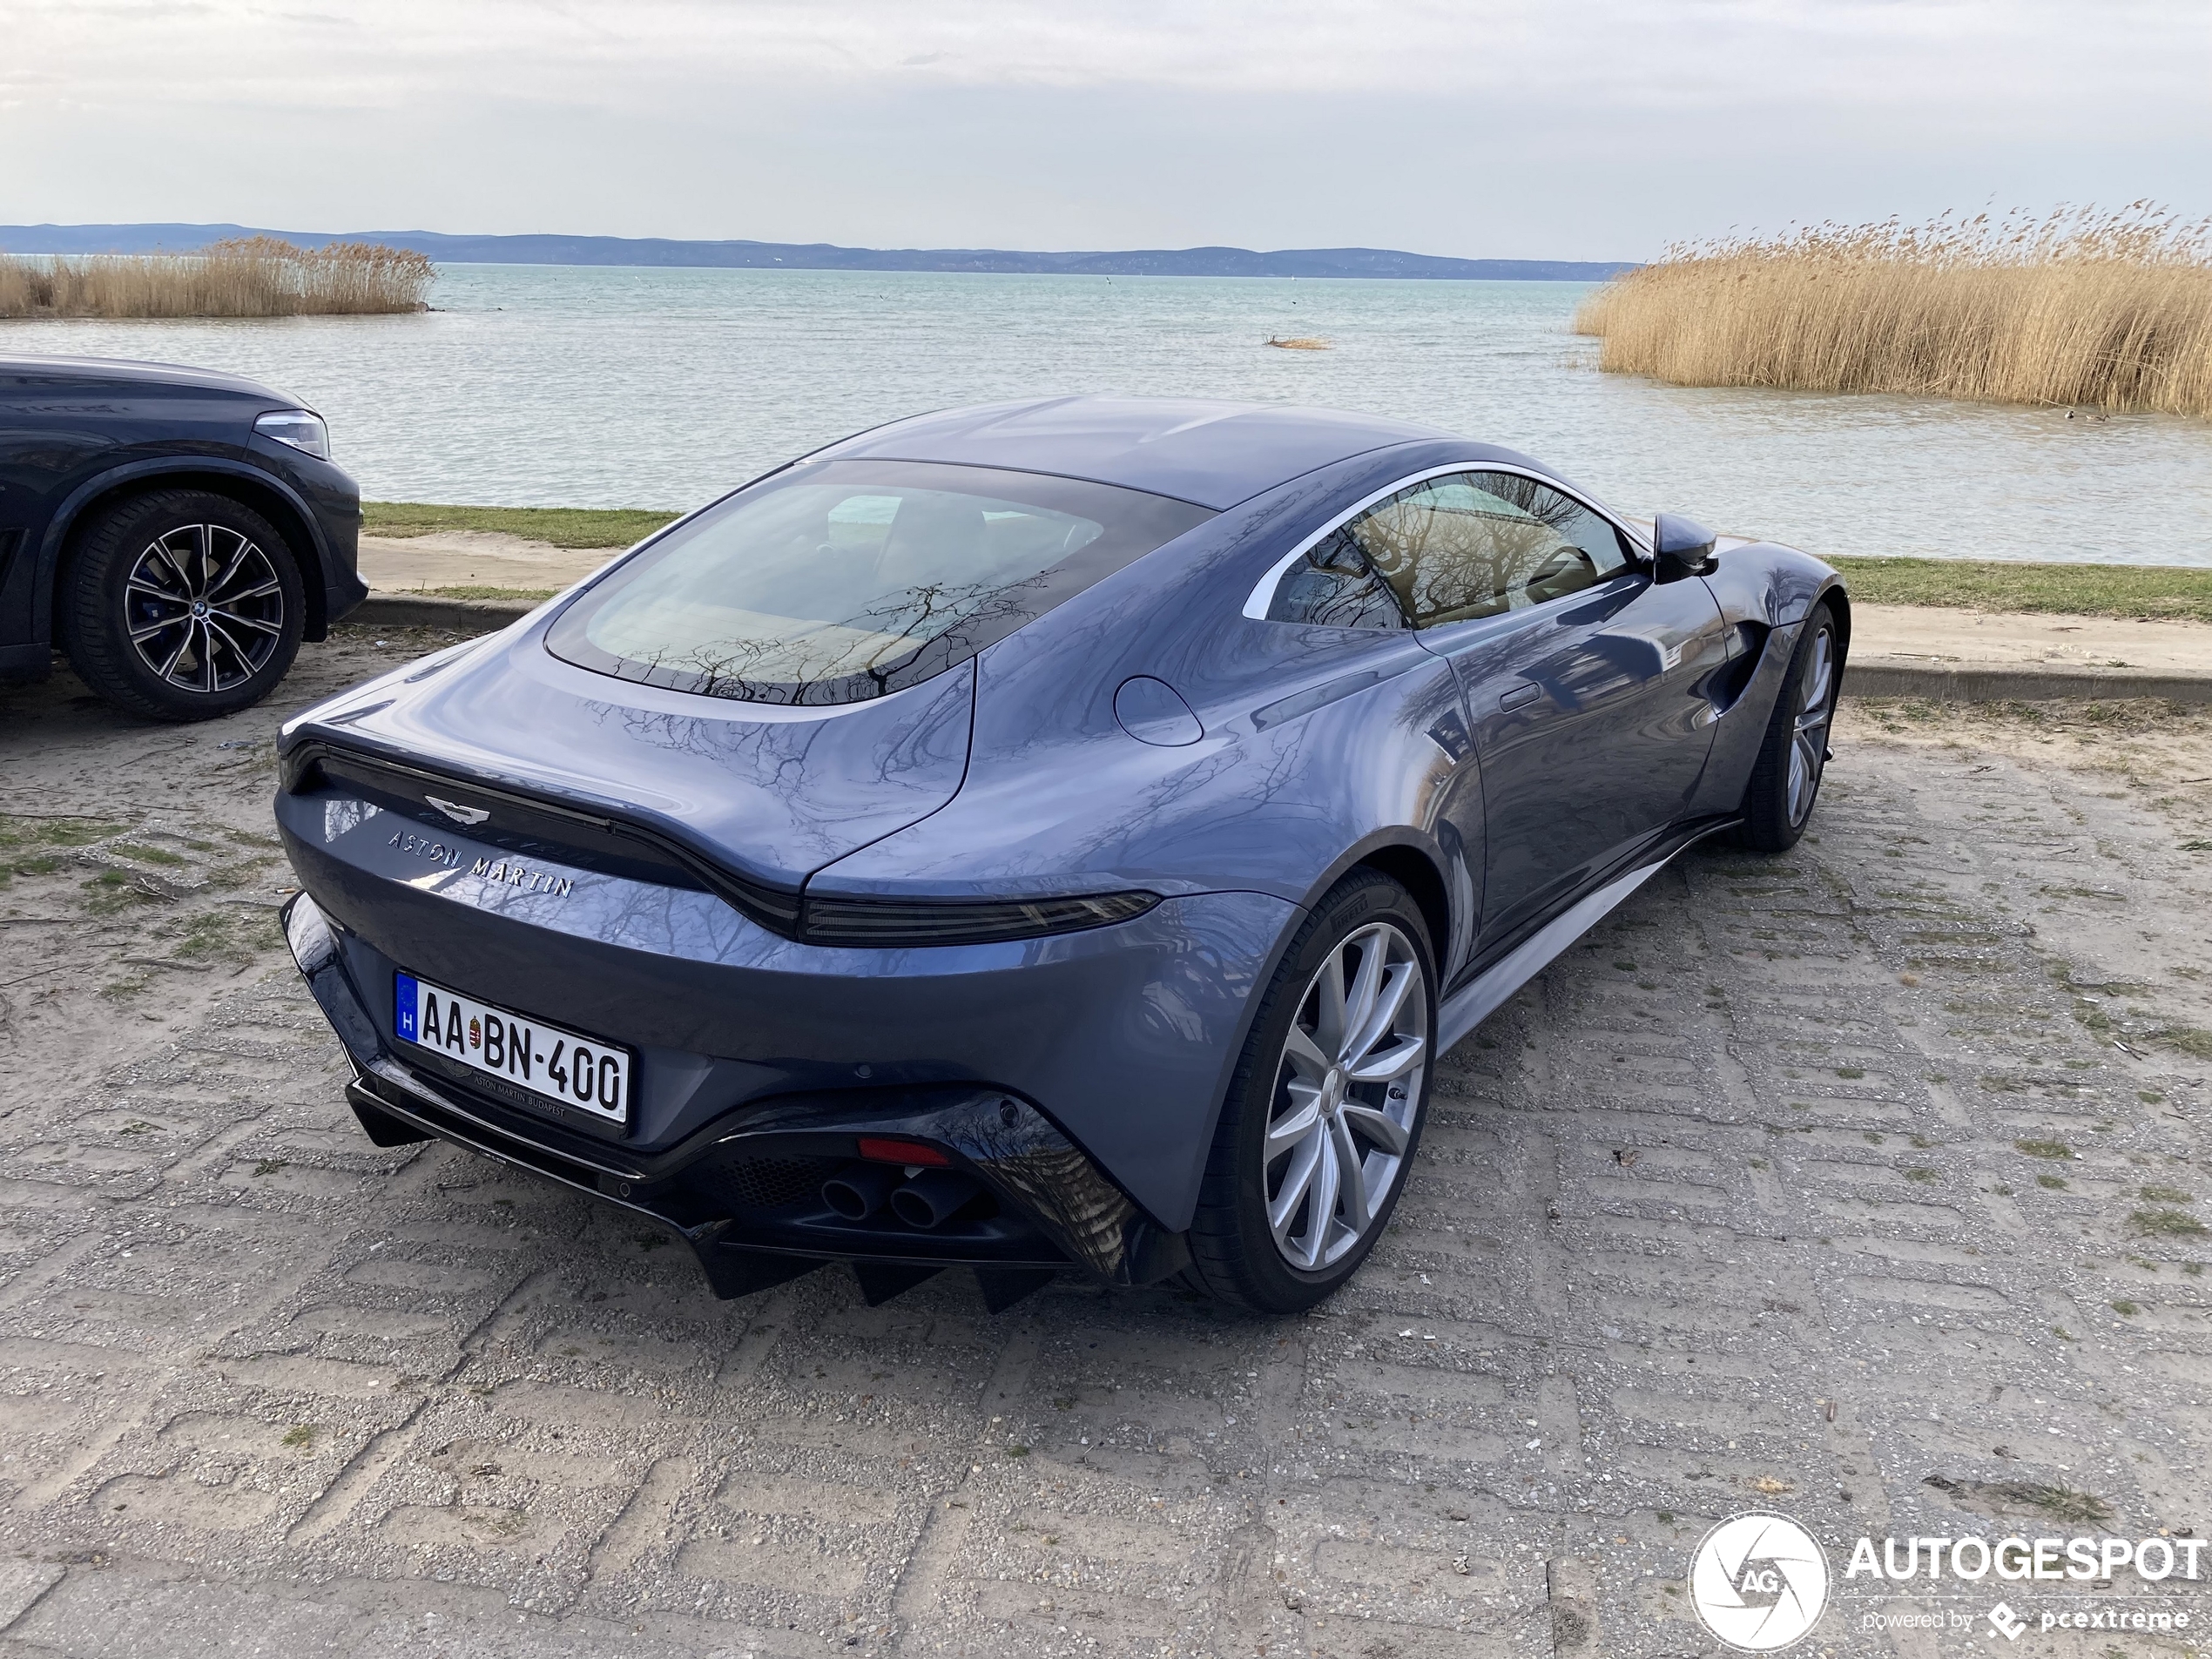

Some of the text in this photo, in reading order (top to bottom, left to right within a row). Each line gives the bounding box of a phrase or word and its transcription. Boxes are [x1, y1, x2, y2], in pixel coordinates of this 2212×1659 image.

[388, 831, 575, 899] ASTON MARTIN
[402, 1011, 413, 1032] H
[475, 1076, 565, 1117] ASTON MARTIN BUDAPEST
